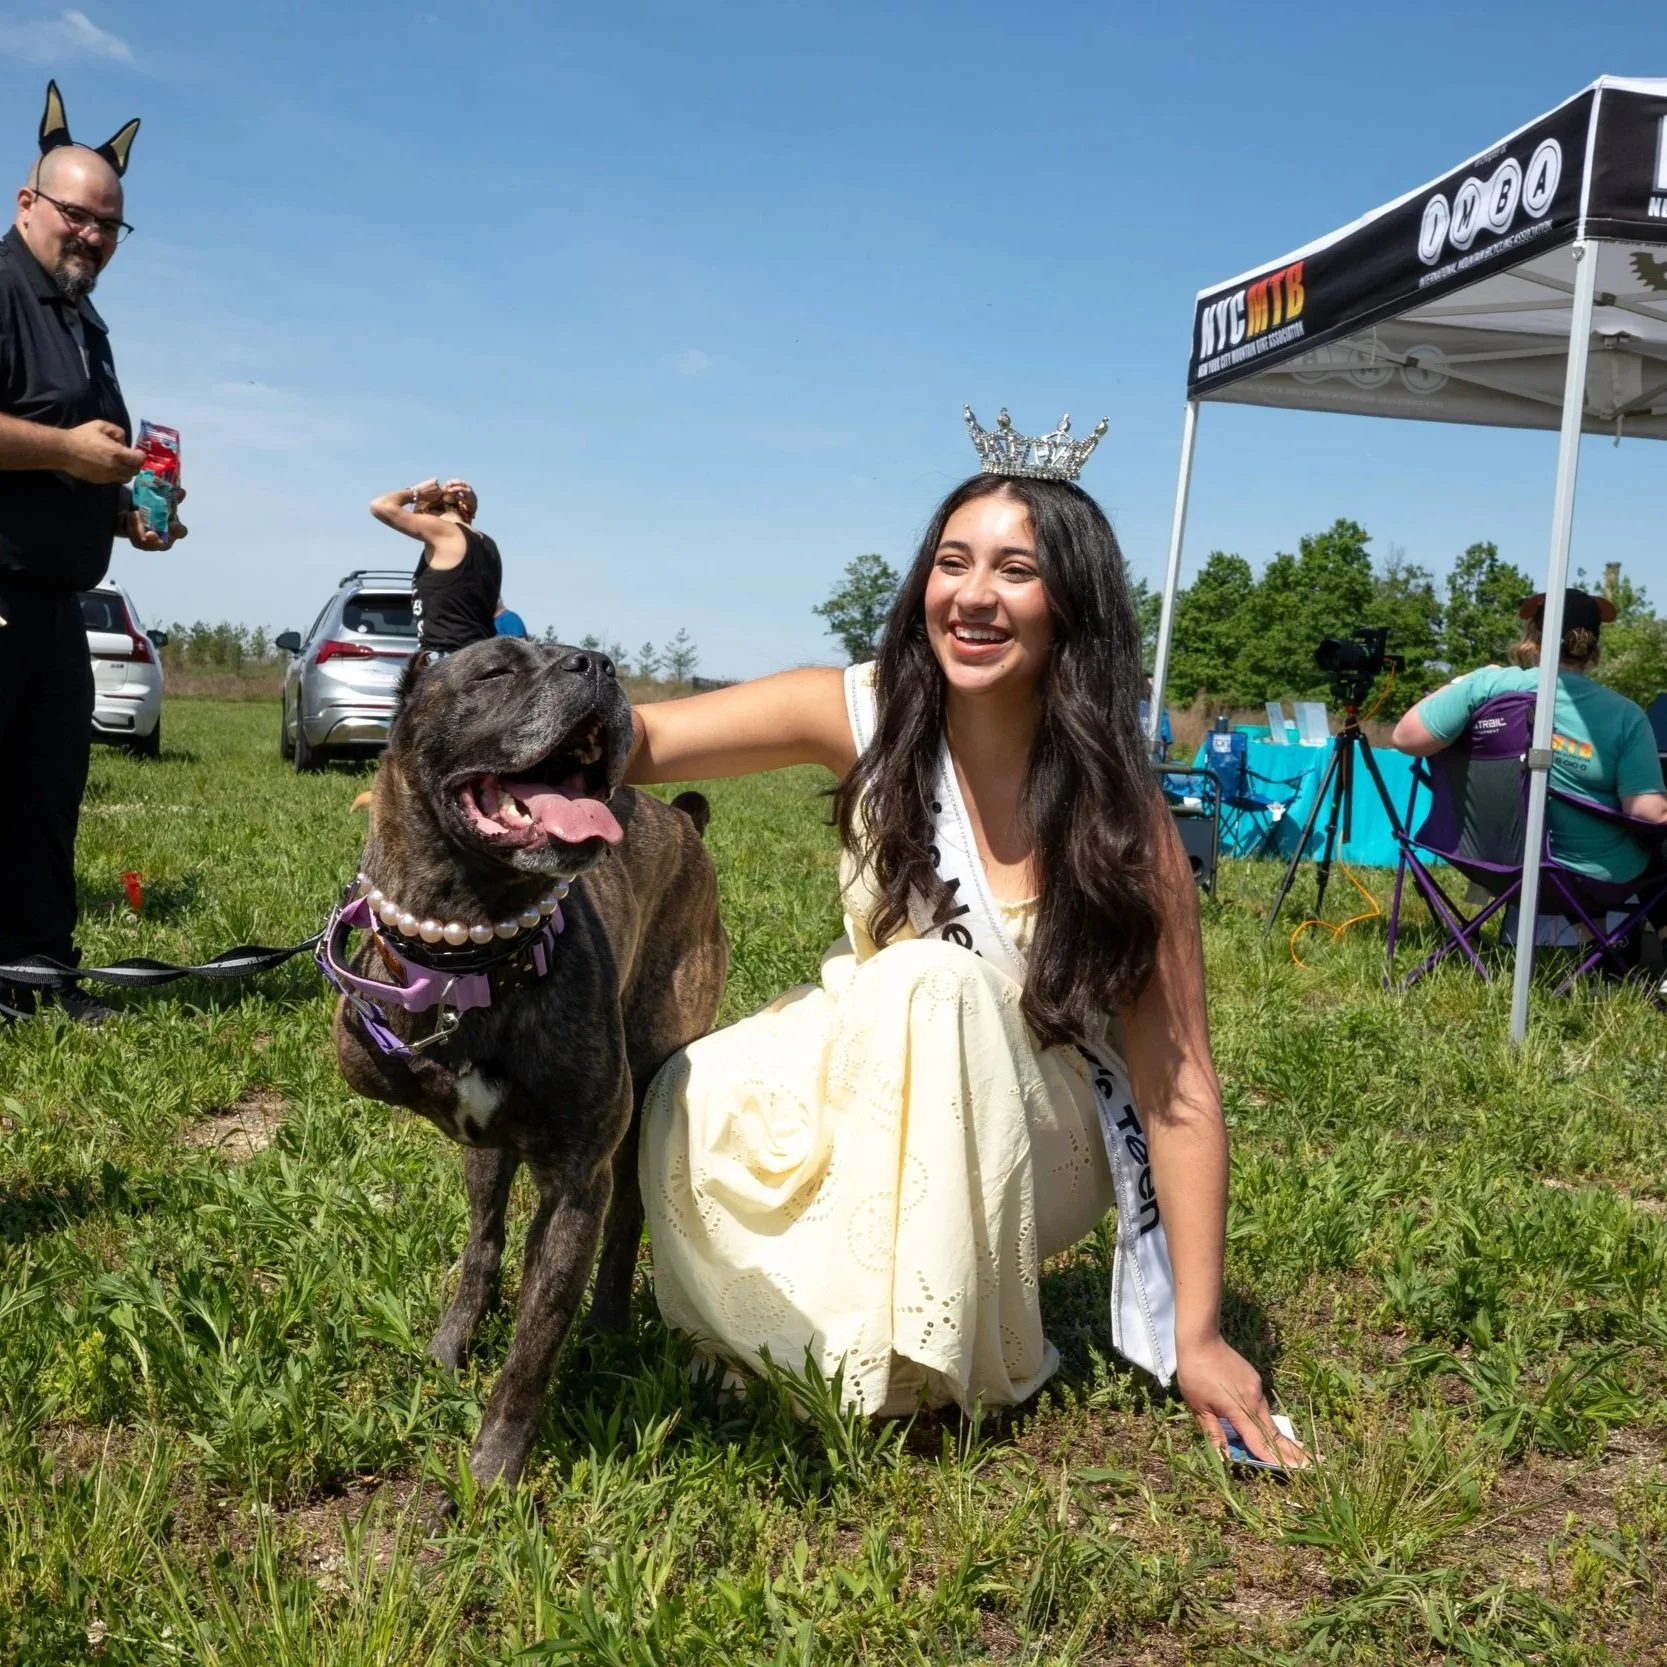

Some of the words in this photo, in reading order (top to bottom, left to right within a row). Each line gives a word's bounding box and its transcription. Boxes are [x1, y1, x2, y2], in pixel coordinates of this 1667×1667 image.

[1426, 158, 1549, 248] IMBA
[1220, 351, 1232, 369] CITY
[1231, 341, 1257, 365] MOUNTAIN
[1268, 320, 1305, 349] ASSOCIATION
[1116, 1103, 1160, 1236] Teen
